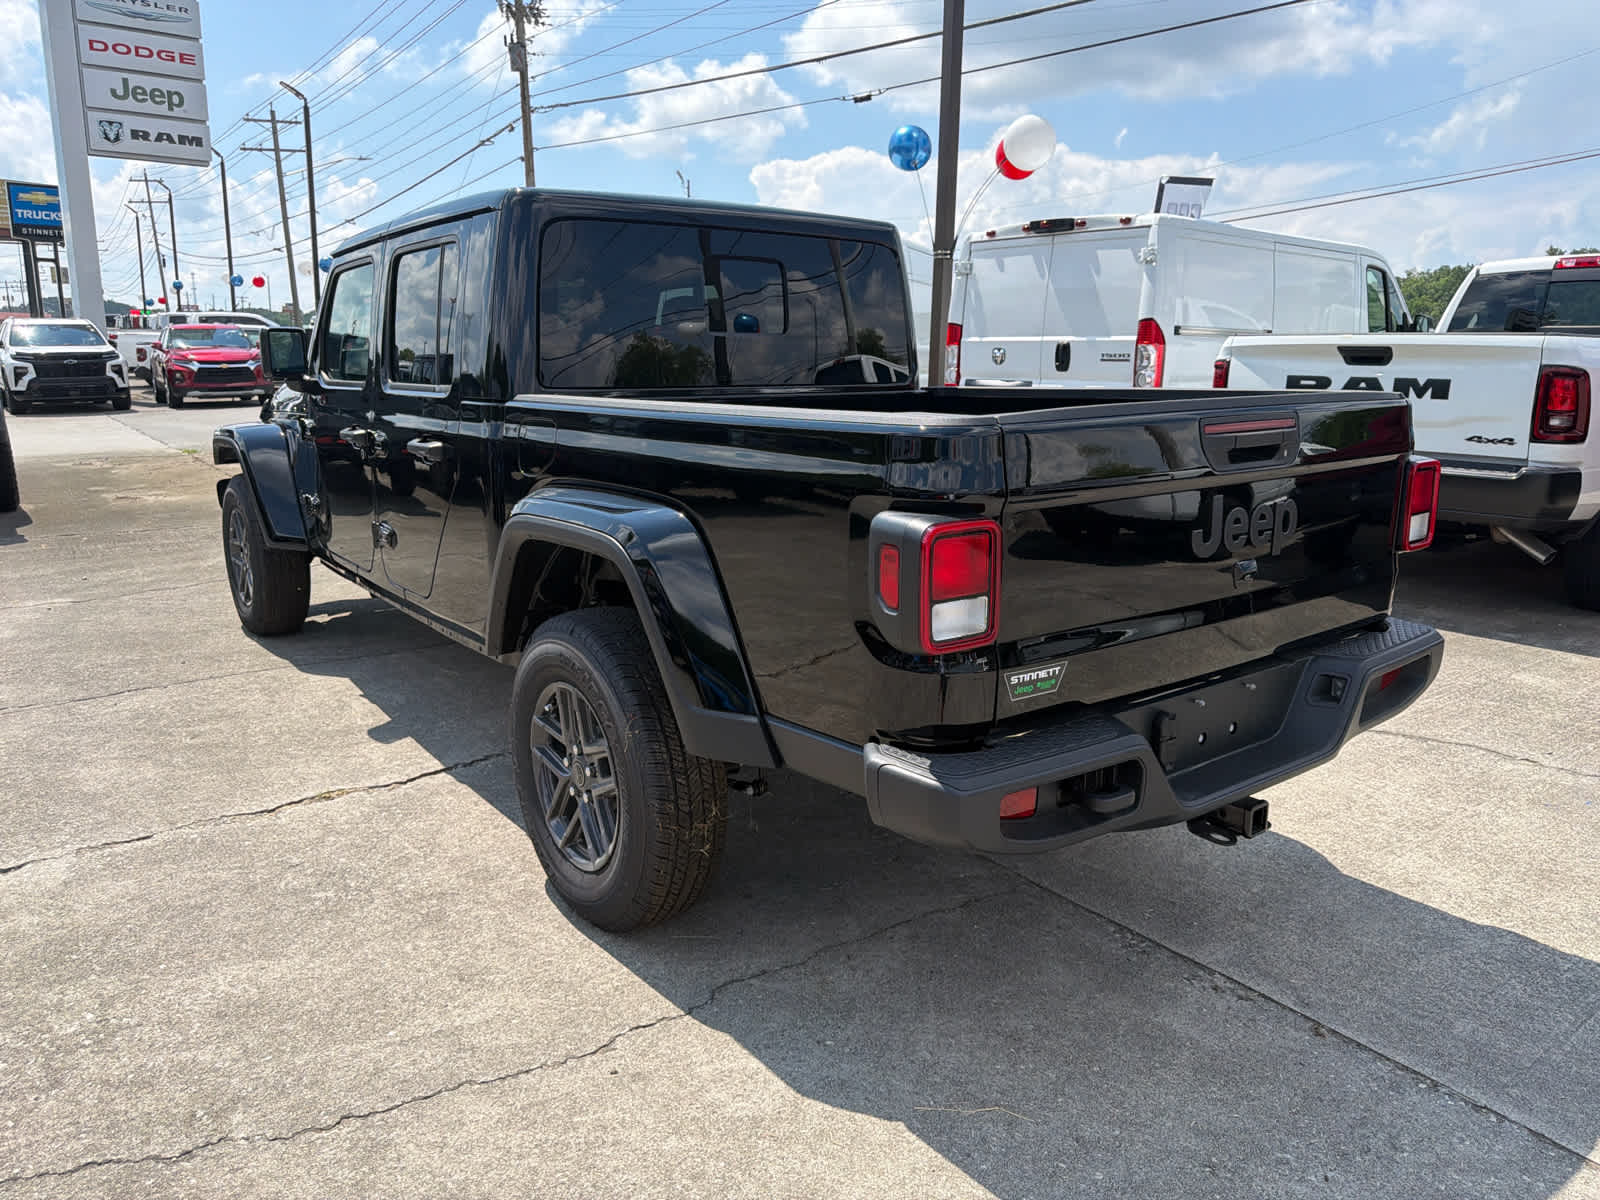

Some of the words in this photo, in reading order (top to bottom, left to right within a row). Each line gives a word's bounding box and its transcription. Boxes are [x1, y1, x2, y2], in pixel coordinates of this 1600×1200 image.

[88, 39, 197, 65] DODGE
[110, 77, 185, 112] Jeep
[130, 129, 204, 147] RAM
[15, 208, 63, 221] TRUCKS
[1464, 435, 1518, 446] 4x4
[1192, 494, 1298, 558] Jeep
[1010, 666, 1061, 685] STINNETT
